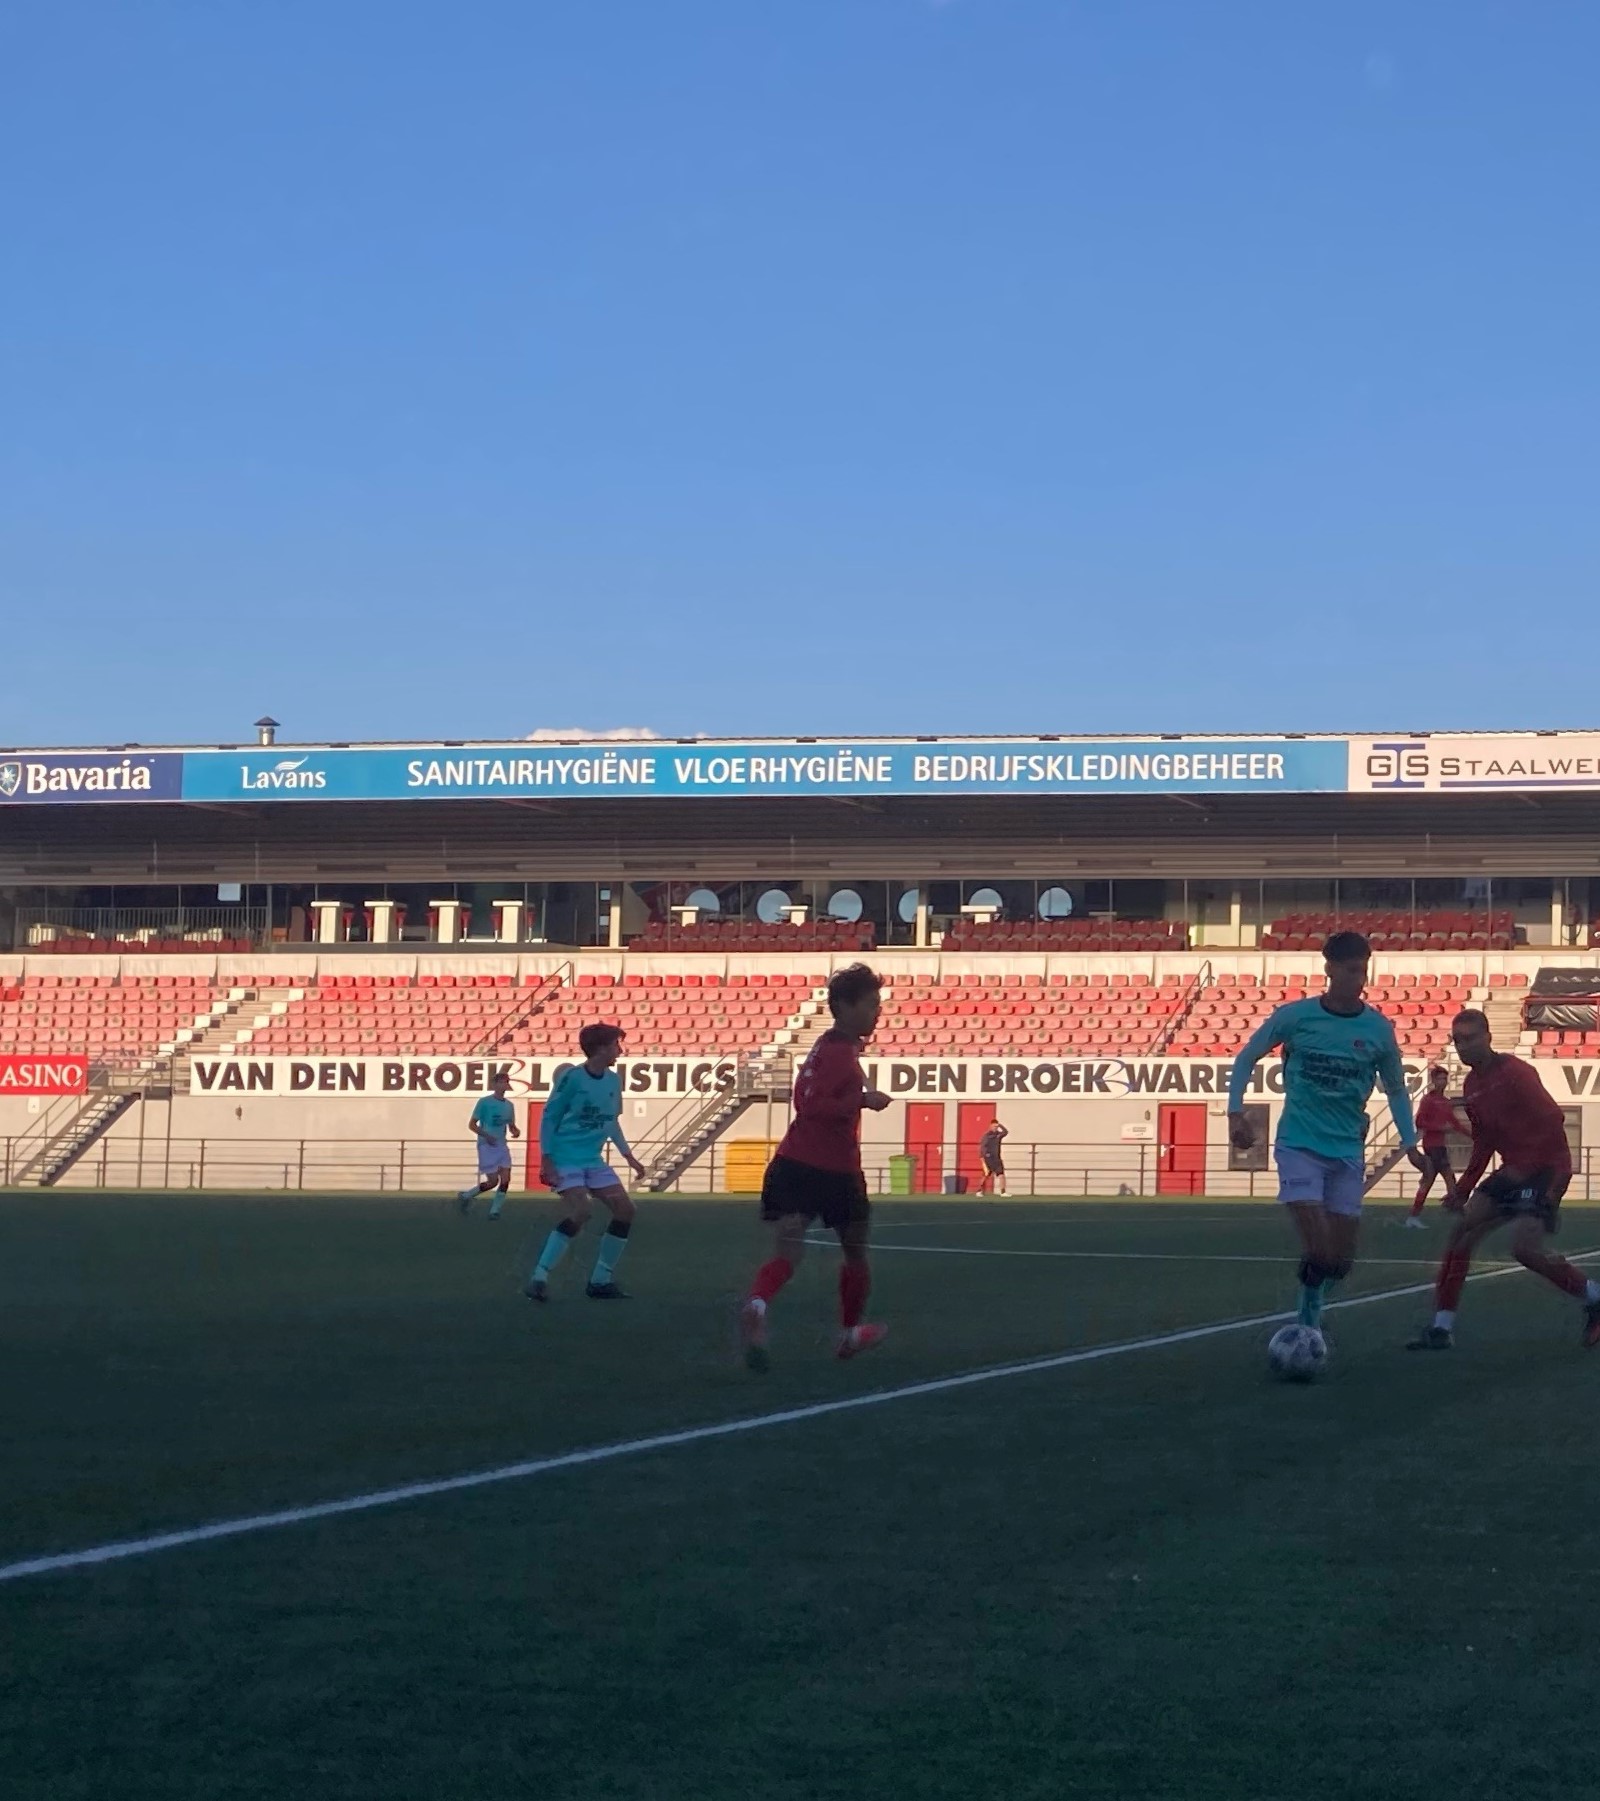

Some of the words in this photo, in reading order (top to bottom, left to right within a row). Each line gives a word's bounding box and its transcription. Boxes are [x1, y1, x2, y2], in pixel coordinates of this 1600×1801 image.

[26, 759, 152, 794] Bavaria
[241, 766, 327, 789] Lavans
[407, 752, 656, 787] SANITAIRHYGIËNE
[674, 750, 893, 784] VLOERHYGIËNE
[914, 754, 1284, 782] BEDRIJFSKLEDINGBEHEER
[0, 1063, 83, 1088] ASINO
[195, 1062, 274, 1091] VAN
[290, 1062, 367, 1091] DEN
[382, 1062, 515, 1092] BROEK
[531, 1063, 736, 1093] LISTICS
[890, 1063, 968, 1093] DEN
[981, 1063, 1112, 1093] BROEK
